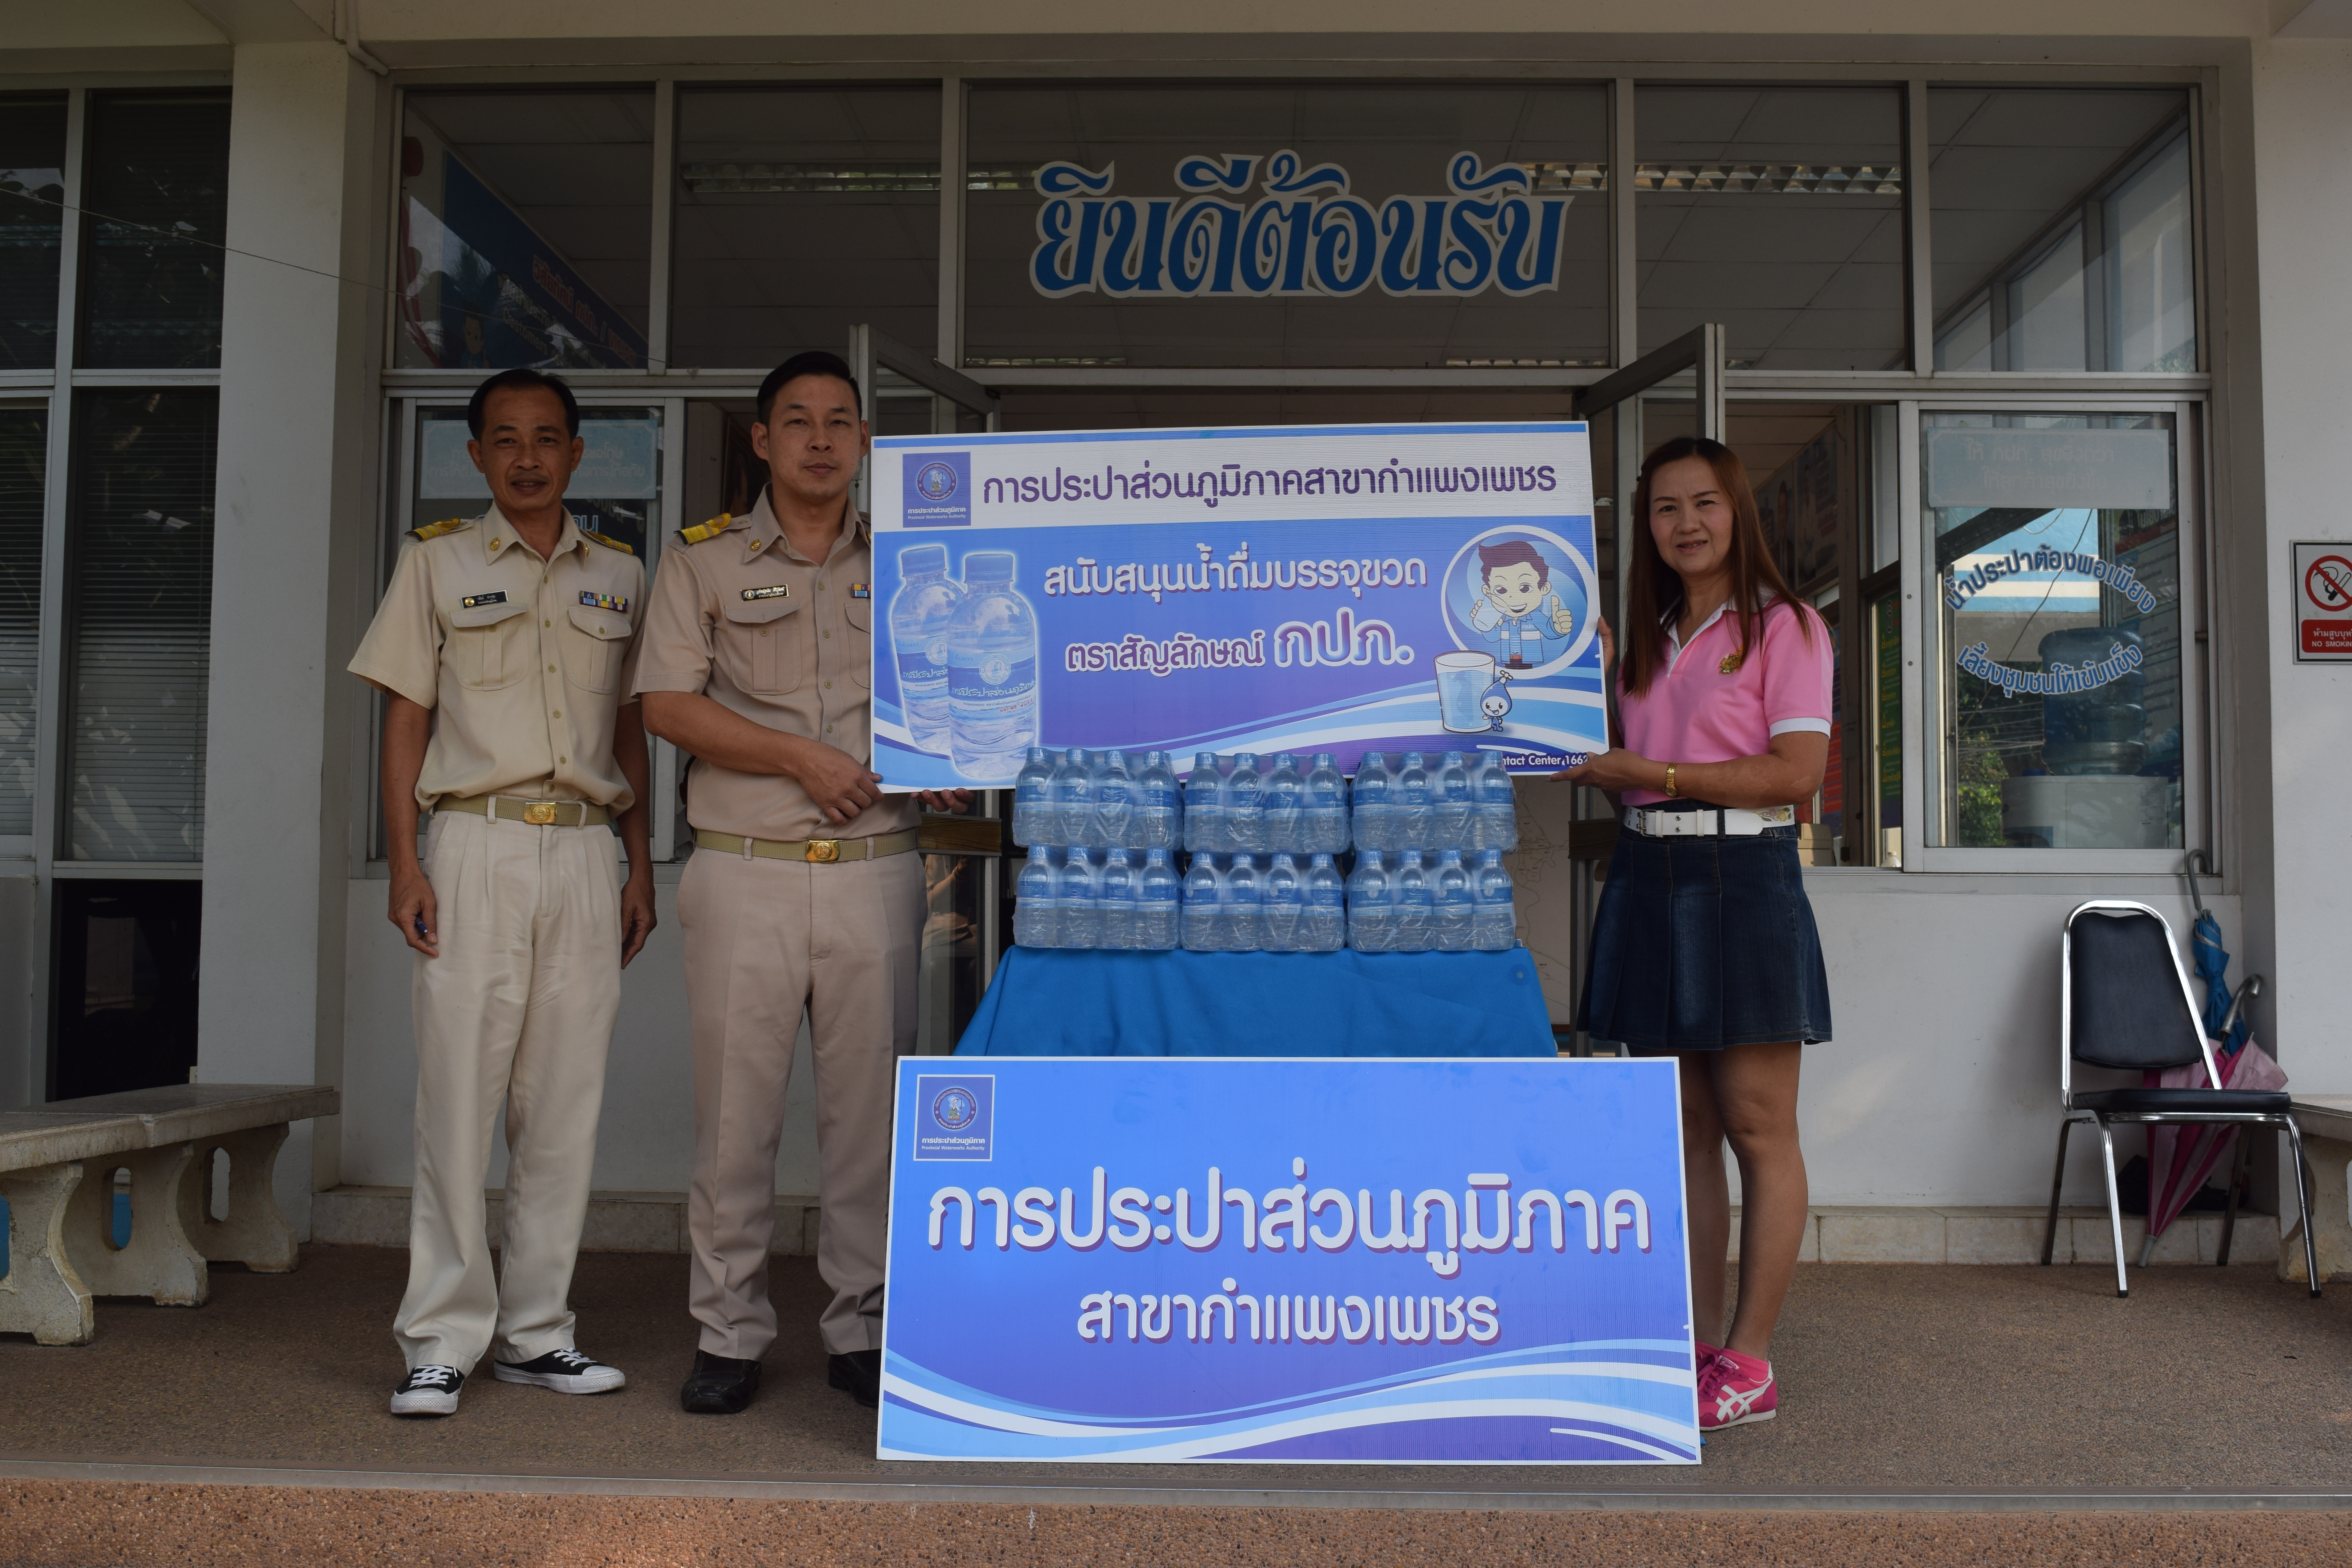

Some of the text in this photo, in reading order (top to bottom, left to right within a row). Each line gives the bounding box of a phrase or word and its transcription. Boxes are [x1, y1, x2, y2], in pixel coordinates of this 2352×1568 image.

[1030, 149, 1574, 299] ยินดีต้อนรับ
[983, 458, 1557, 508] การประปาส่วนภูมิภาคสาขากำแพงเพชร
[1043, 541, 1428, 605] สนับสนุนน้ำดื่มบรรจุขวด
[1944, 543, 2157, 614] น้ำประปาต้องพอเพียง
[1065, 606, 1416, 677] ตราสัญลักษณ์ กปภ.
[2313, 628, 2352, 640] ห้ามสูบบุห
[1956, 641, 2143, 699] เลี้ยงชุมชนให้เข้มแข็ง
[1503, 757, 1525, 765] ntact
[1528, 756, 1561, 765] Center
[922, 1137, 985, 1145] การประปาส่วนภูมิภาค
[928, 1157, 1651, 1279] การประปาส่วนภูมิภาค
[1077, 1277, 1500, 1345] สาขากำแพงเพชร
